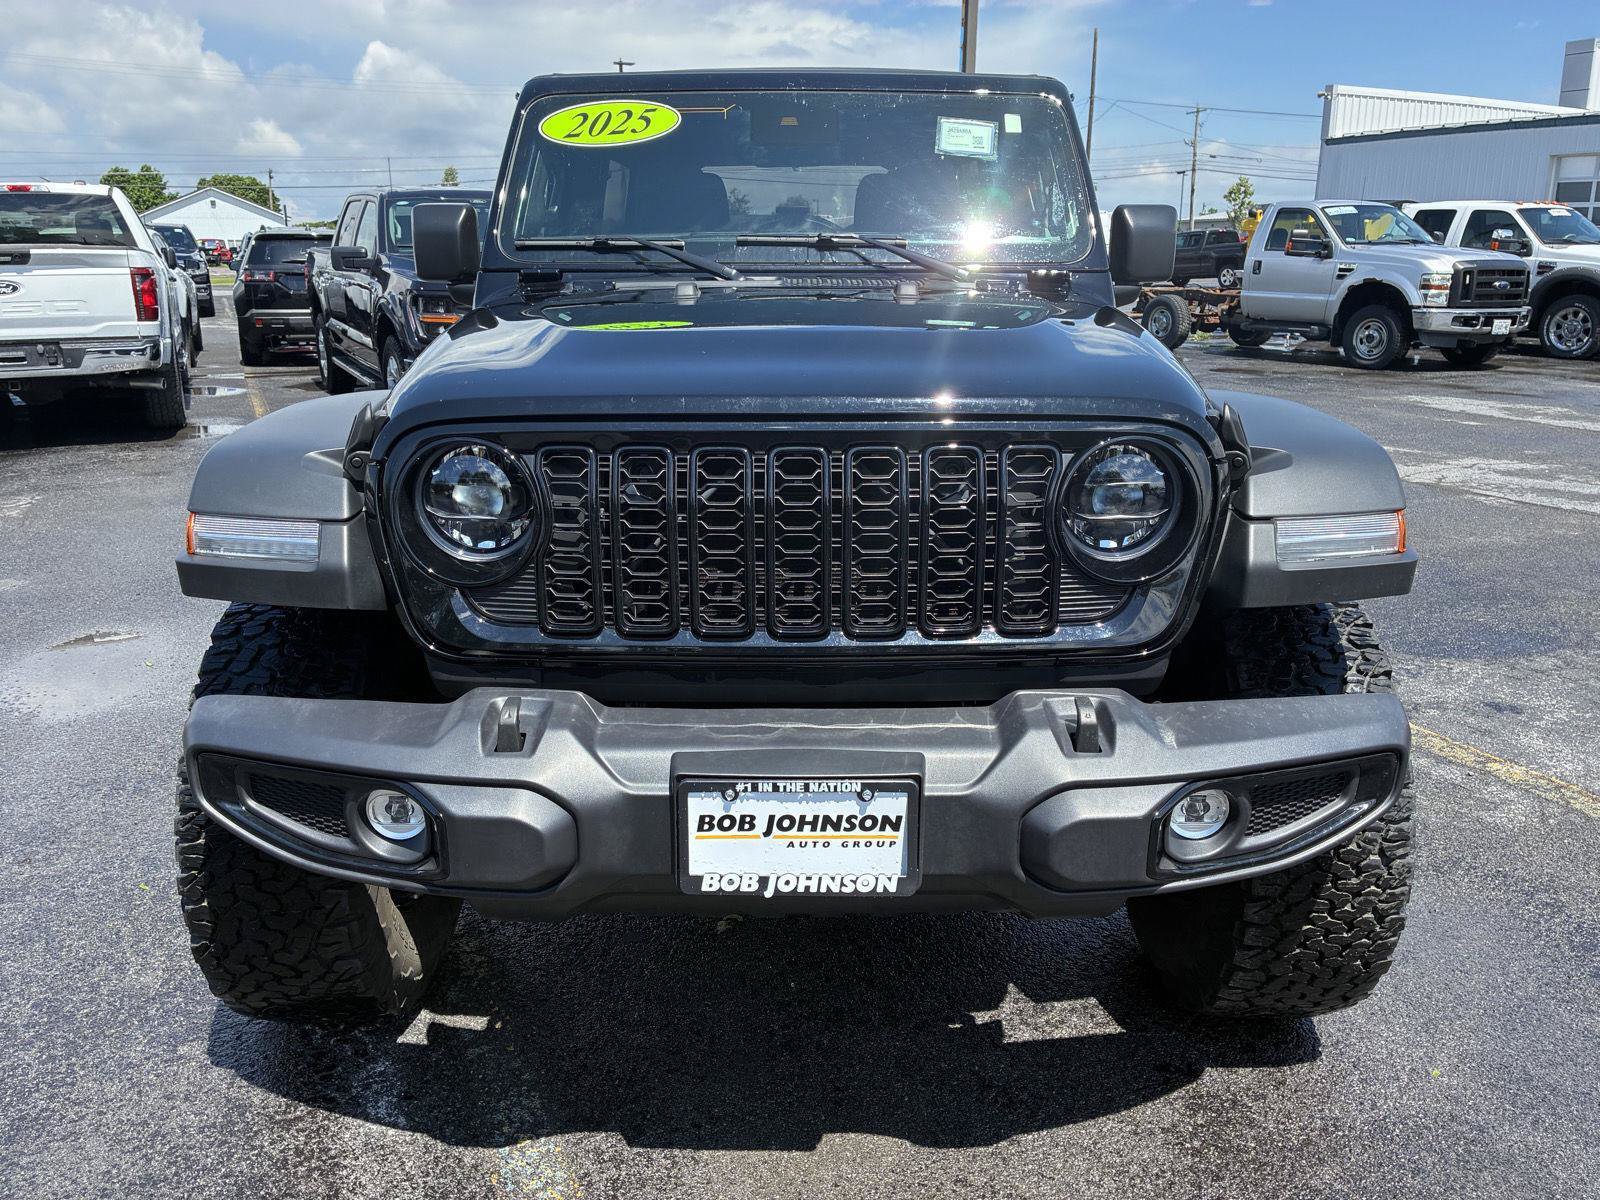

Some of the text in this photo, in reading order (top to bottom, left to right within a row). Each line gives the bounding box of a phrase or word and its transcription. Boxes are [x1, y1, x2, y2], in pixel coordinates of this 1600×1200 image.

[563, 108, 658, 138] 2025
[735, 782, 862, 793] #1 IN THE NATION
[696, 814, 903, 838] BOB JOHNSON
[787, 840, 897, 849] AUTO GROUP
[701, 872, 900, 898] BOB JOHNSON
